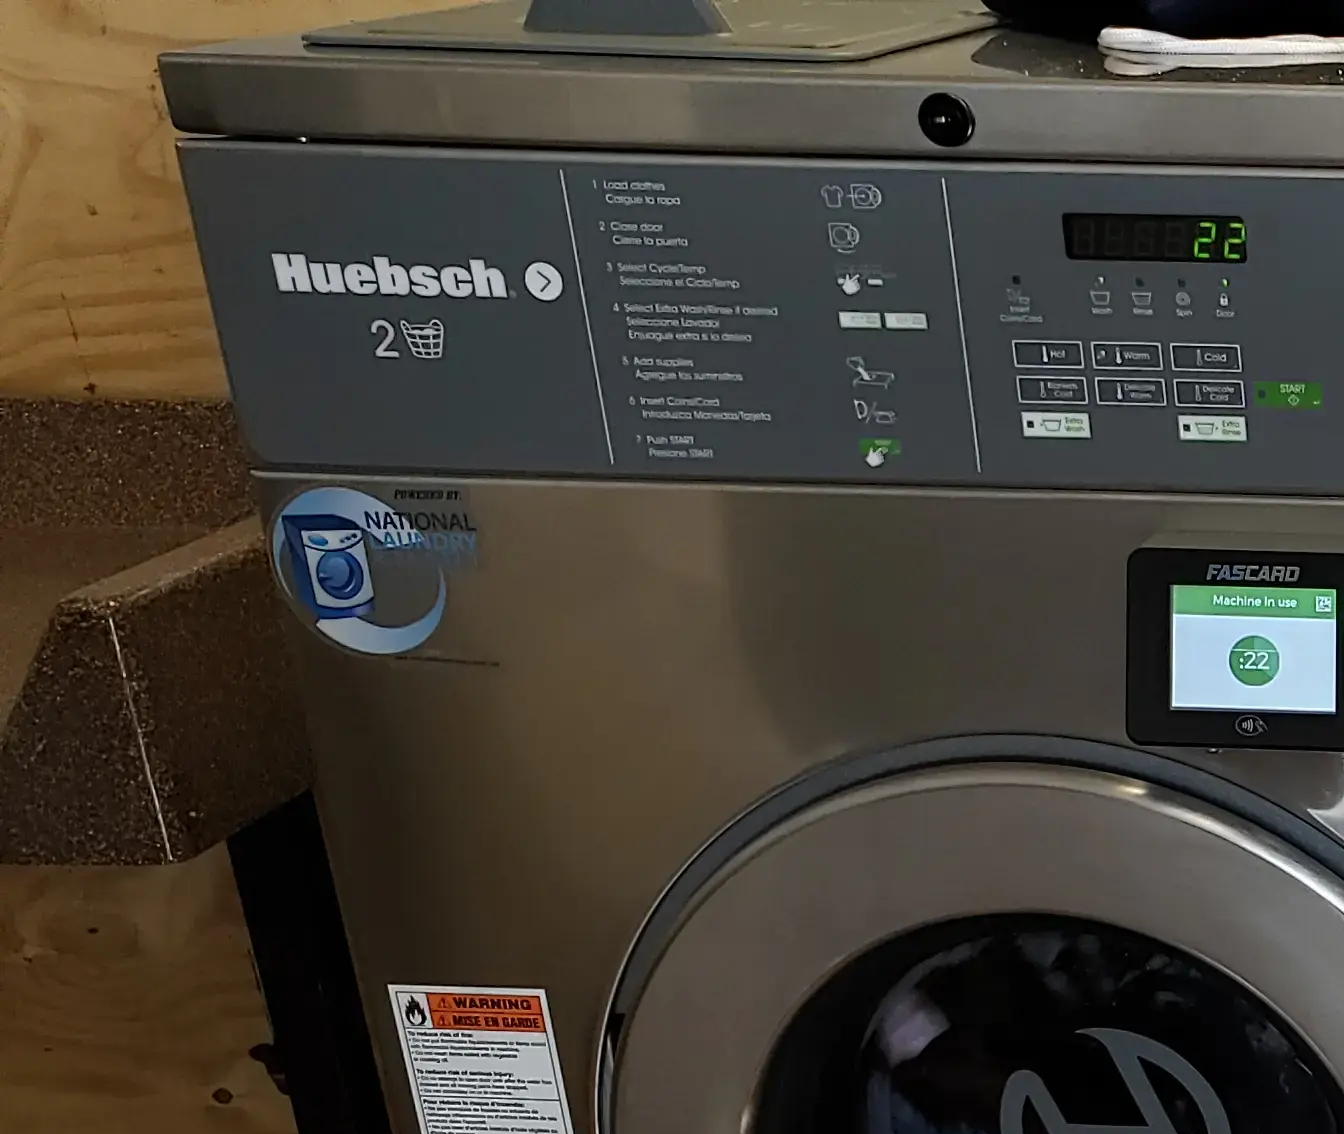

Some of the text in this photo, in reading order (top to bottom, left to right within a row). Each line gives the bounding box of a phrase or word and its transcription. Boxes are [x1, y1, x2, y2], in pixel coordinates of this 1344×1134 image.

[1193, 221, 1246, 259] 22
[271, 252, 508, 299] Huebsch
[370, 318, 400, 358] 2
[1050, 349, 1066, 358] Hot
[1123, 351, 1150, 360] Warm
[1204, 353, 1227, 362] Cold
[1279, 383, 1306, 395] START
[364, 511, 477, 532] NATIONAL
[1206, 564, 1300, 582] FASCARD
[1213, 594, 1297, 608] Machine in use
[1239, 651, 1270, 670] :22
[452, 996, 531, 1011] WARNING
[452, 1015, 540, 1028] MISE EN GARDE
